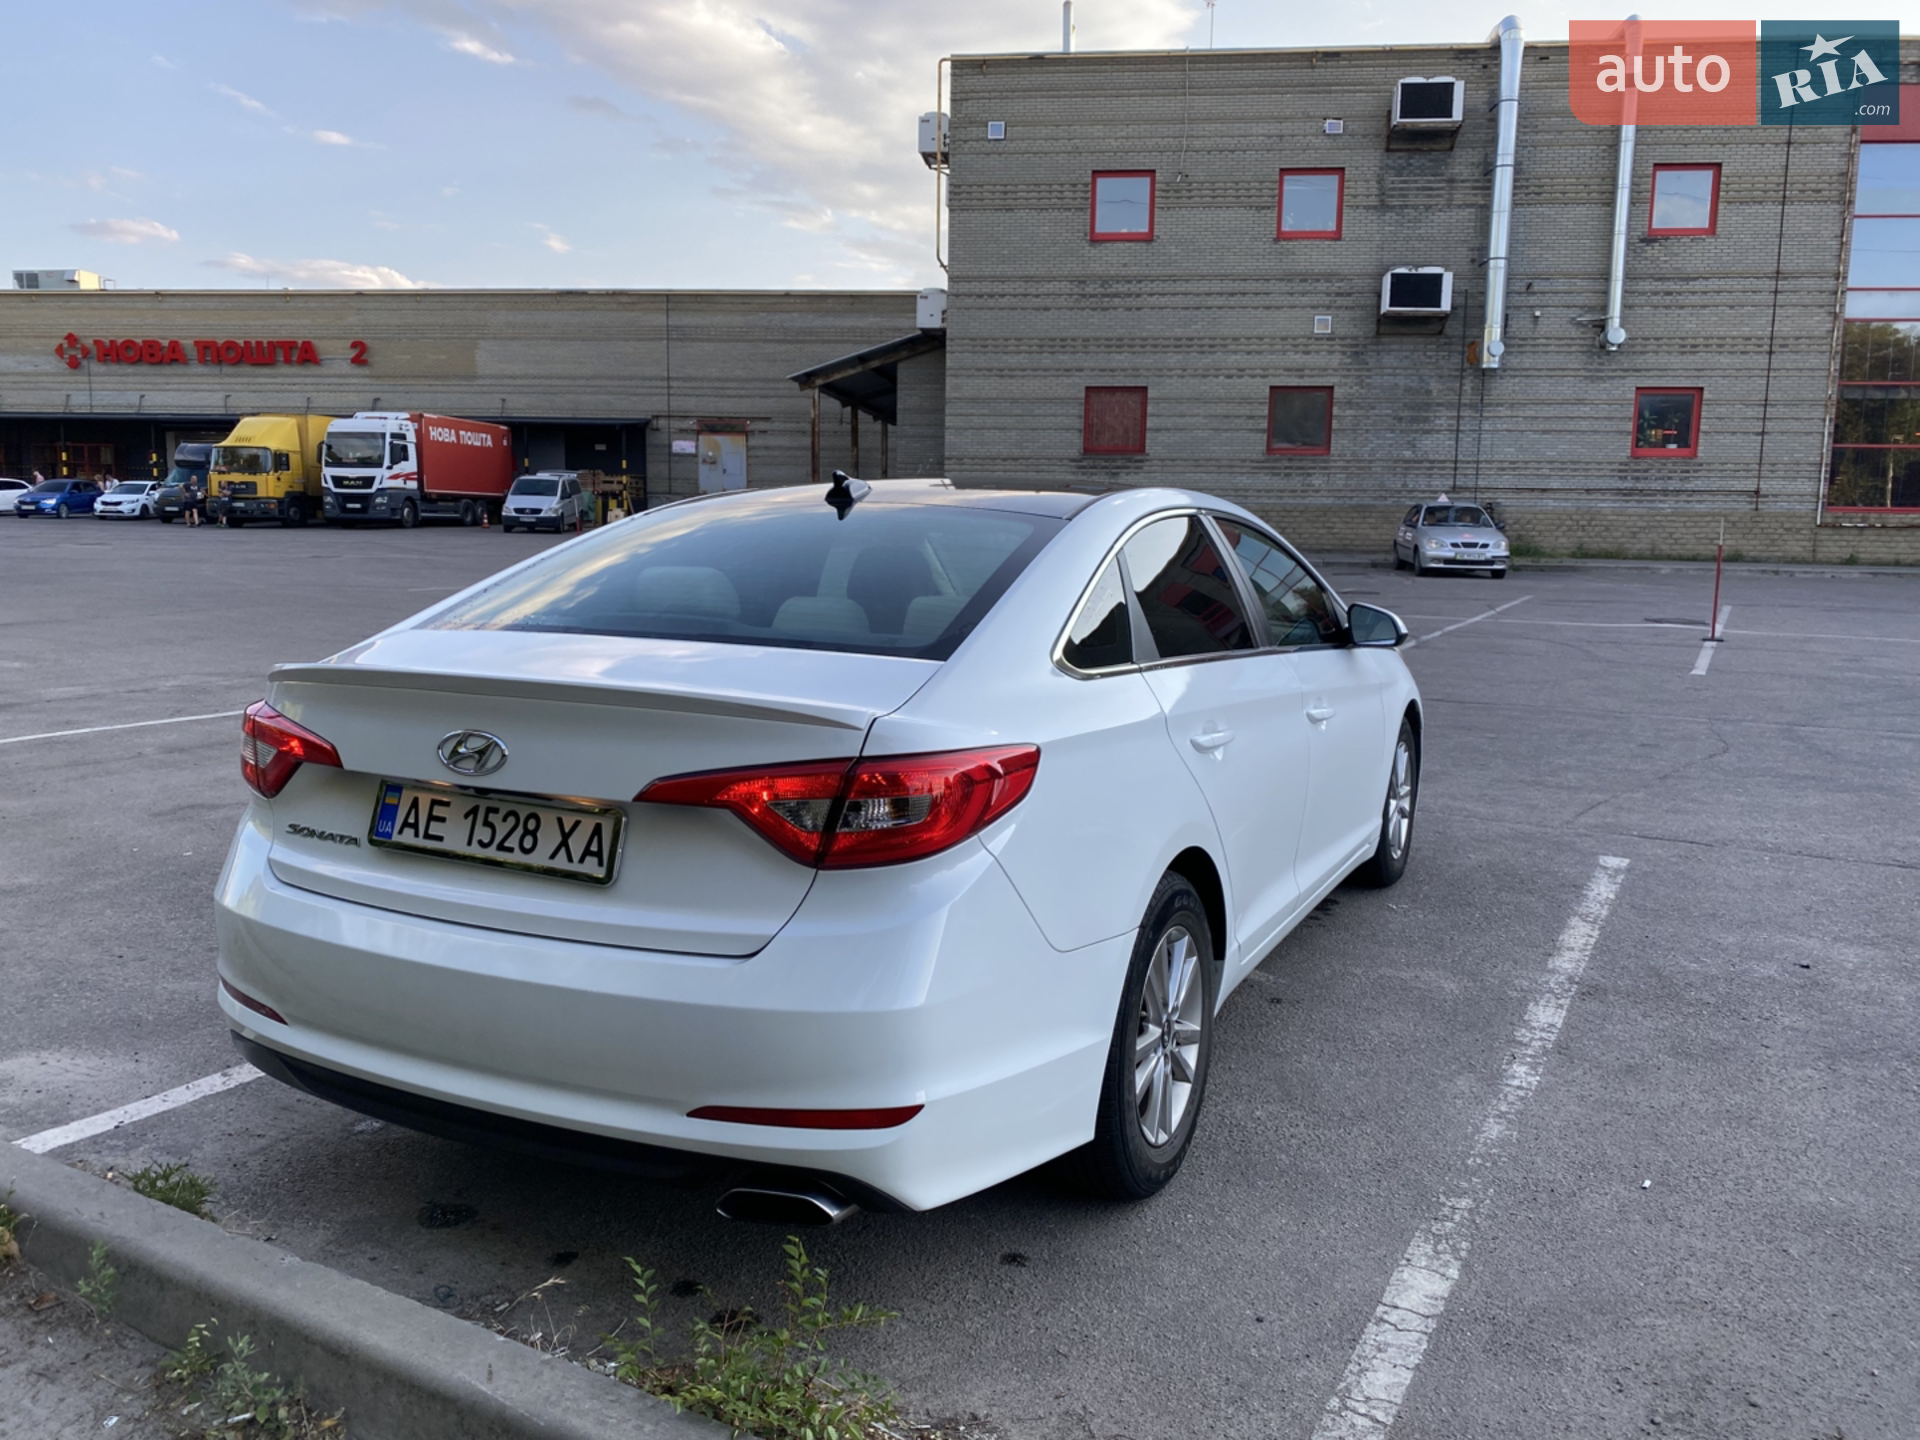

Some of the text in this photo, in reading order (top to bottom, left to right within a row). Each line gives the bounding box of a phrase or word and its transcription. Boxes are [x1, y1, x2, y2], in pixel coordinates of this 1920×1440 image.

[93, 339, 369, 366] НОВА ПОШТА 2
[428, 426, 493, 448] НОВА ПОШТА
[285, 823, 361, 848] SONATA
[378, 820, 392, 834] UA
[397, 796, 604, 867] AE 1528 XA
